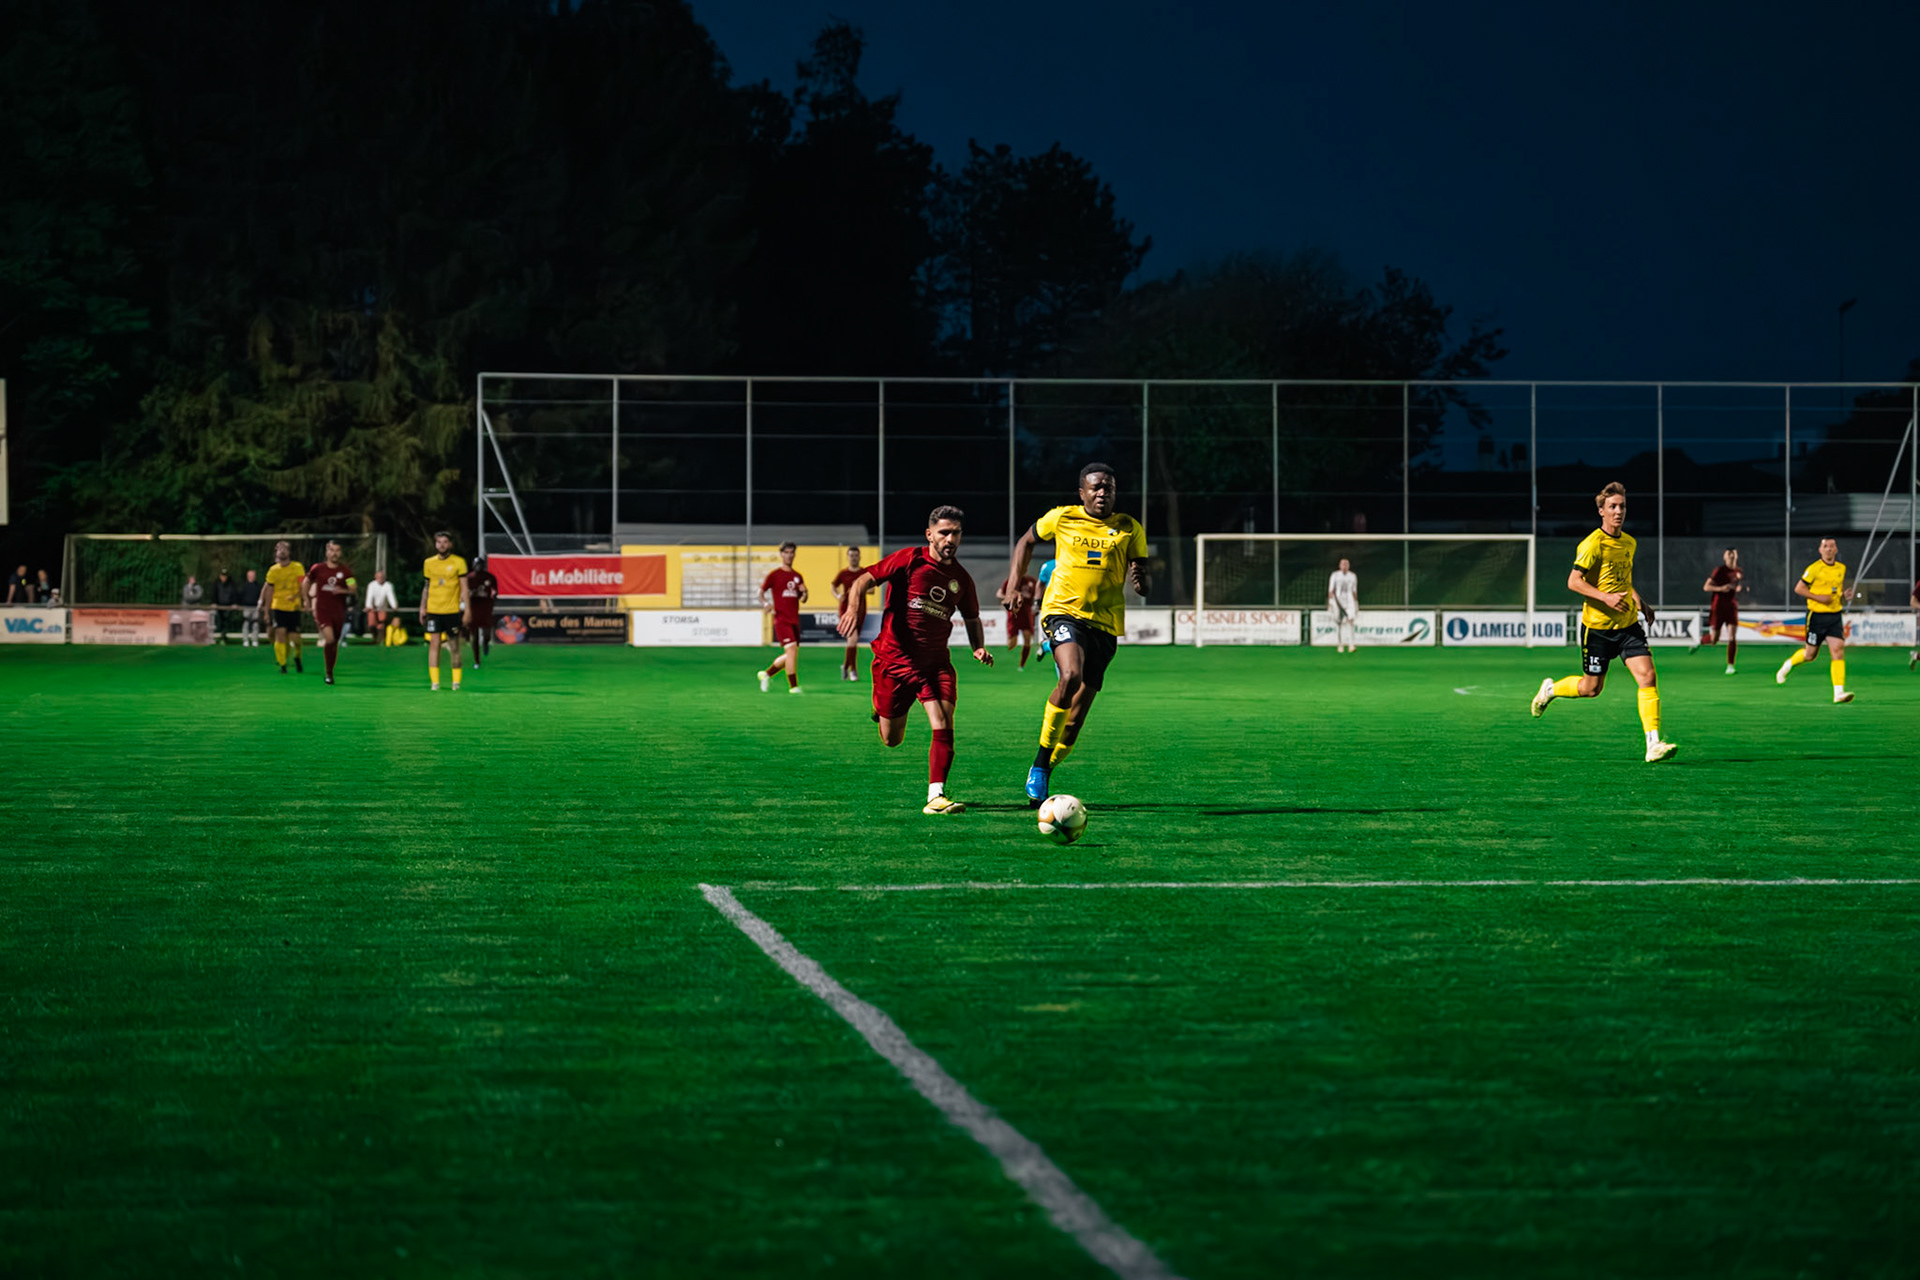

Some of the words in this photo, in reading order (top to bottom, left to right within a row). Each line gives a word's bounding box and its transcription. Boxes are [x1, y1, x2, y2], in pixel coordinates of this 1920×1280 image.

[531, 569, 546, 585] la
[549, 568, 623, 584] Mobilière
[528, 616, 557, 629] Cave
[560, 616, 580, 628] des
[584, 616, 625, 628] Marnes
[662, 615, 699, 624] STORSA
[814, 614, 839, 625] TRIS
[1589, 655, 1600, 666] 15
